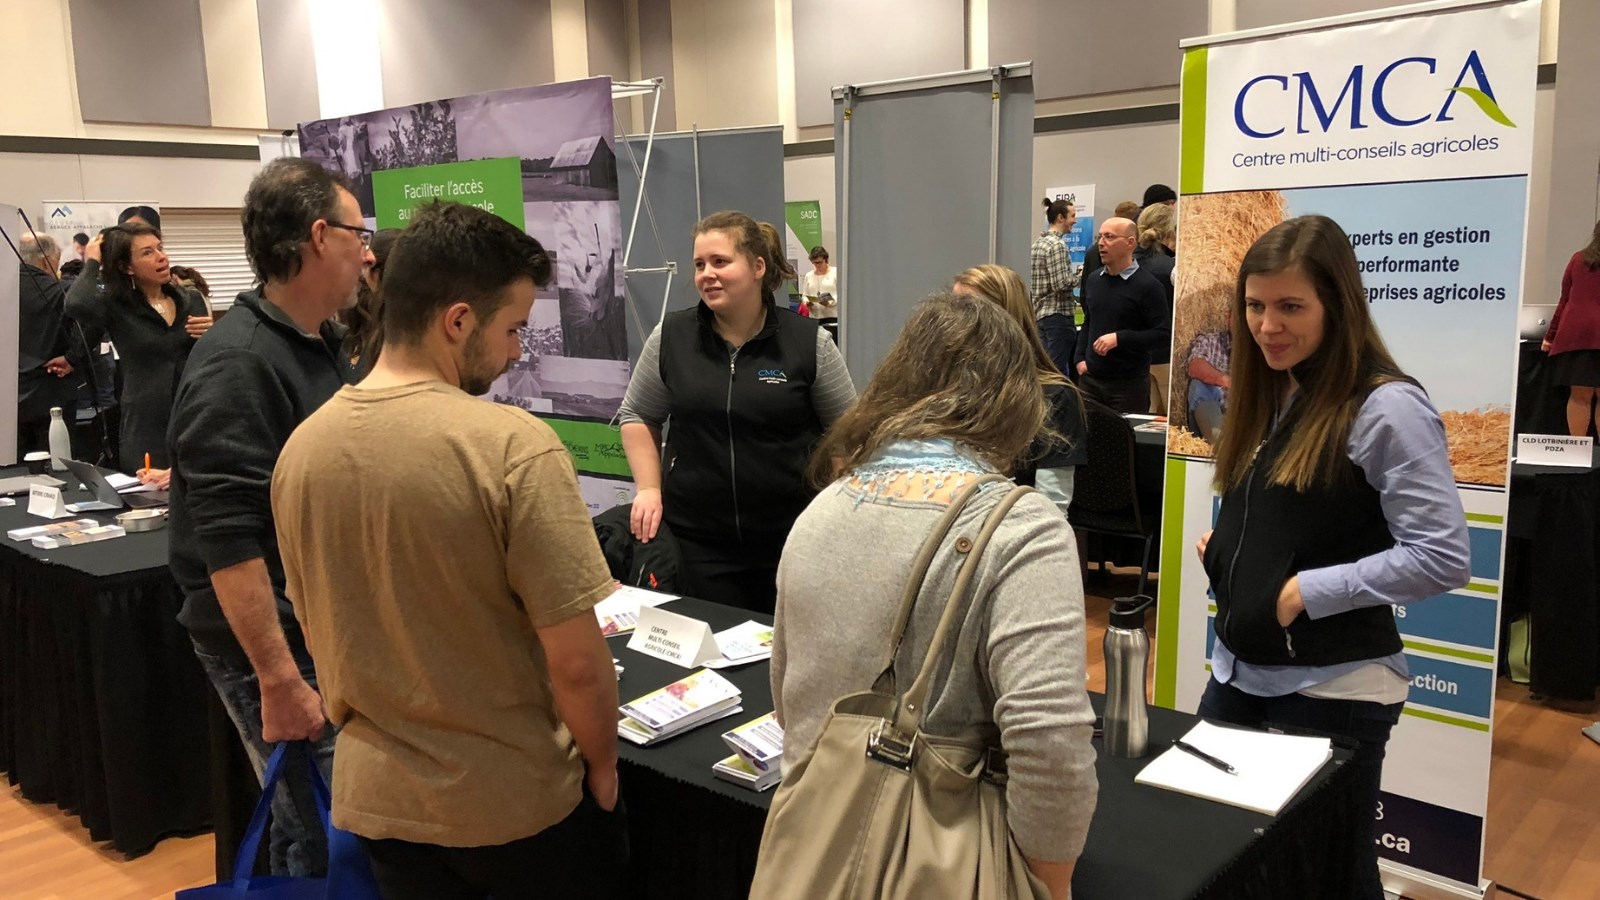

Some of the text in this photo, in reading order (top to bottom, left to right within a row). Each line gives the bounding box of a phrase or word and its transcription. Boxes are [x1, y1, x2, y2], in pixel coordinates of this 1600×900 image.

[1234, 50, 1517, 139] CMCA
[1232, 134, 1500, 168] Centre multi-conseils agricoles
[404, 179, 484, 199] Faciliter l'accès
[398, 208, 411, 220] au
[800, 210, 818, 219] SADC
[1347, 226, 1490, 249] perts en gestion
[1357, 256, 1460, 273] performante
[1363, 283, 1506, 304] eprises agricoles
[651, 626, 668, 636] CENTRE
[644, 643, 666, 655] AGRICOLE
[1408, 674, 1458, 695] ction
[1375, 833, 1411, 854] .ca
